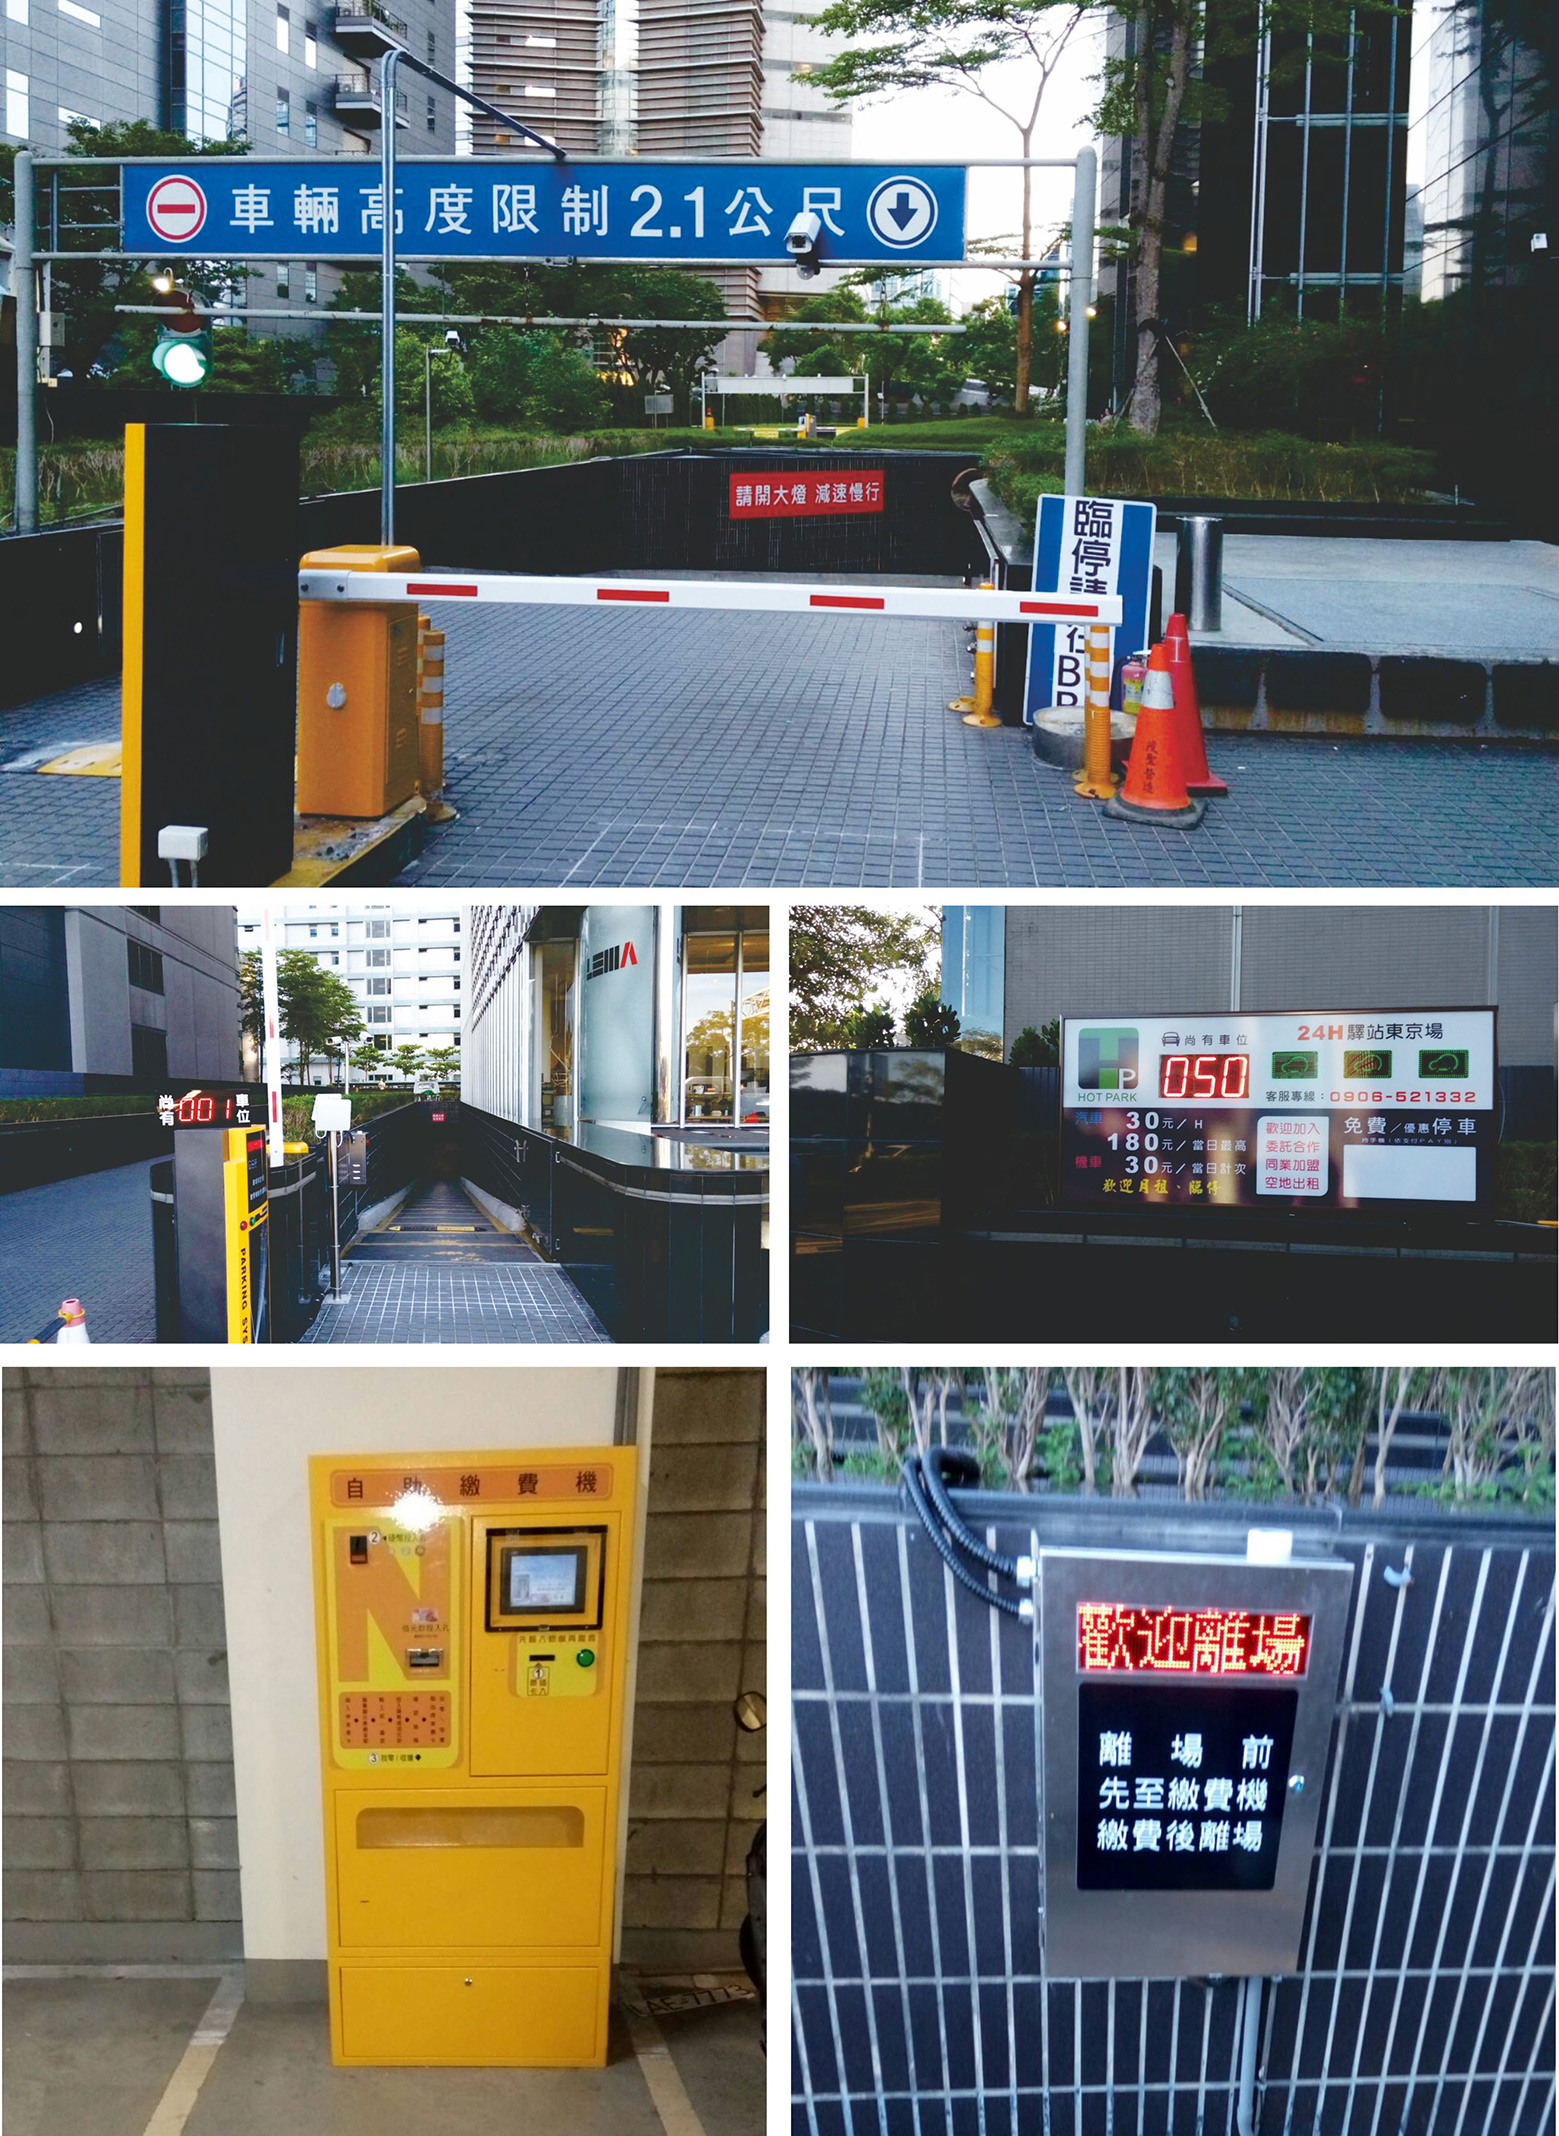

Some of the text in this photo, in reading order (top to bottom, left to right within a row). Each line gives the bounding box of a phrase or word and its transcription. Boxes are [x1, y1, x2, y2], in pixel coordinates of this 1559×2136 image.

[229, 184, 845, 238] 車輛高度限制2.1公尺
[735, 482, 880, 507] 請開大燈 減速慢行
[1184, 1034, 1248, 1046] 尚有車位
[1163, 1056, 1248, 1098] 050
[1077, 1092, 1138, 1102] HOT PARK
[1329, 1091, 1477, 1103] 0906-521332
[179, 1098, 231, 1122] 001
[1075, 1111, 1103, 1126] 汽車
[1265, 1121, 1321, 1135] 歡迎加入
[1265, 1140, 1321, 1154] 委託合作
[1075, 1155, 1102, 1169] 機車
[1265, 1158, 1321, 1172] 同業加盟
[1265, 1176, 1320, 1190] 空地出租
[240, 1247, 248, 1310] PARKING
[347, 1471, 597, 1499] 自助繳費機
[371, 1531, 379, 1543] 2
[1078, 1604, 1305, 1675] 歡迎離場
[369, 1753, 378, 1763] 3
[1099, 1731, 1274, 1770] 離場前
[1099, 1776, 1269, 1812] 先至繳費機
[1097, 1818, 1263, 1853] 繳費後離場
